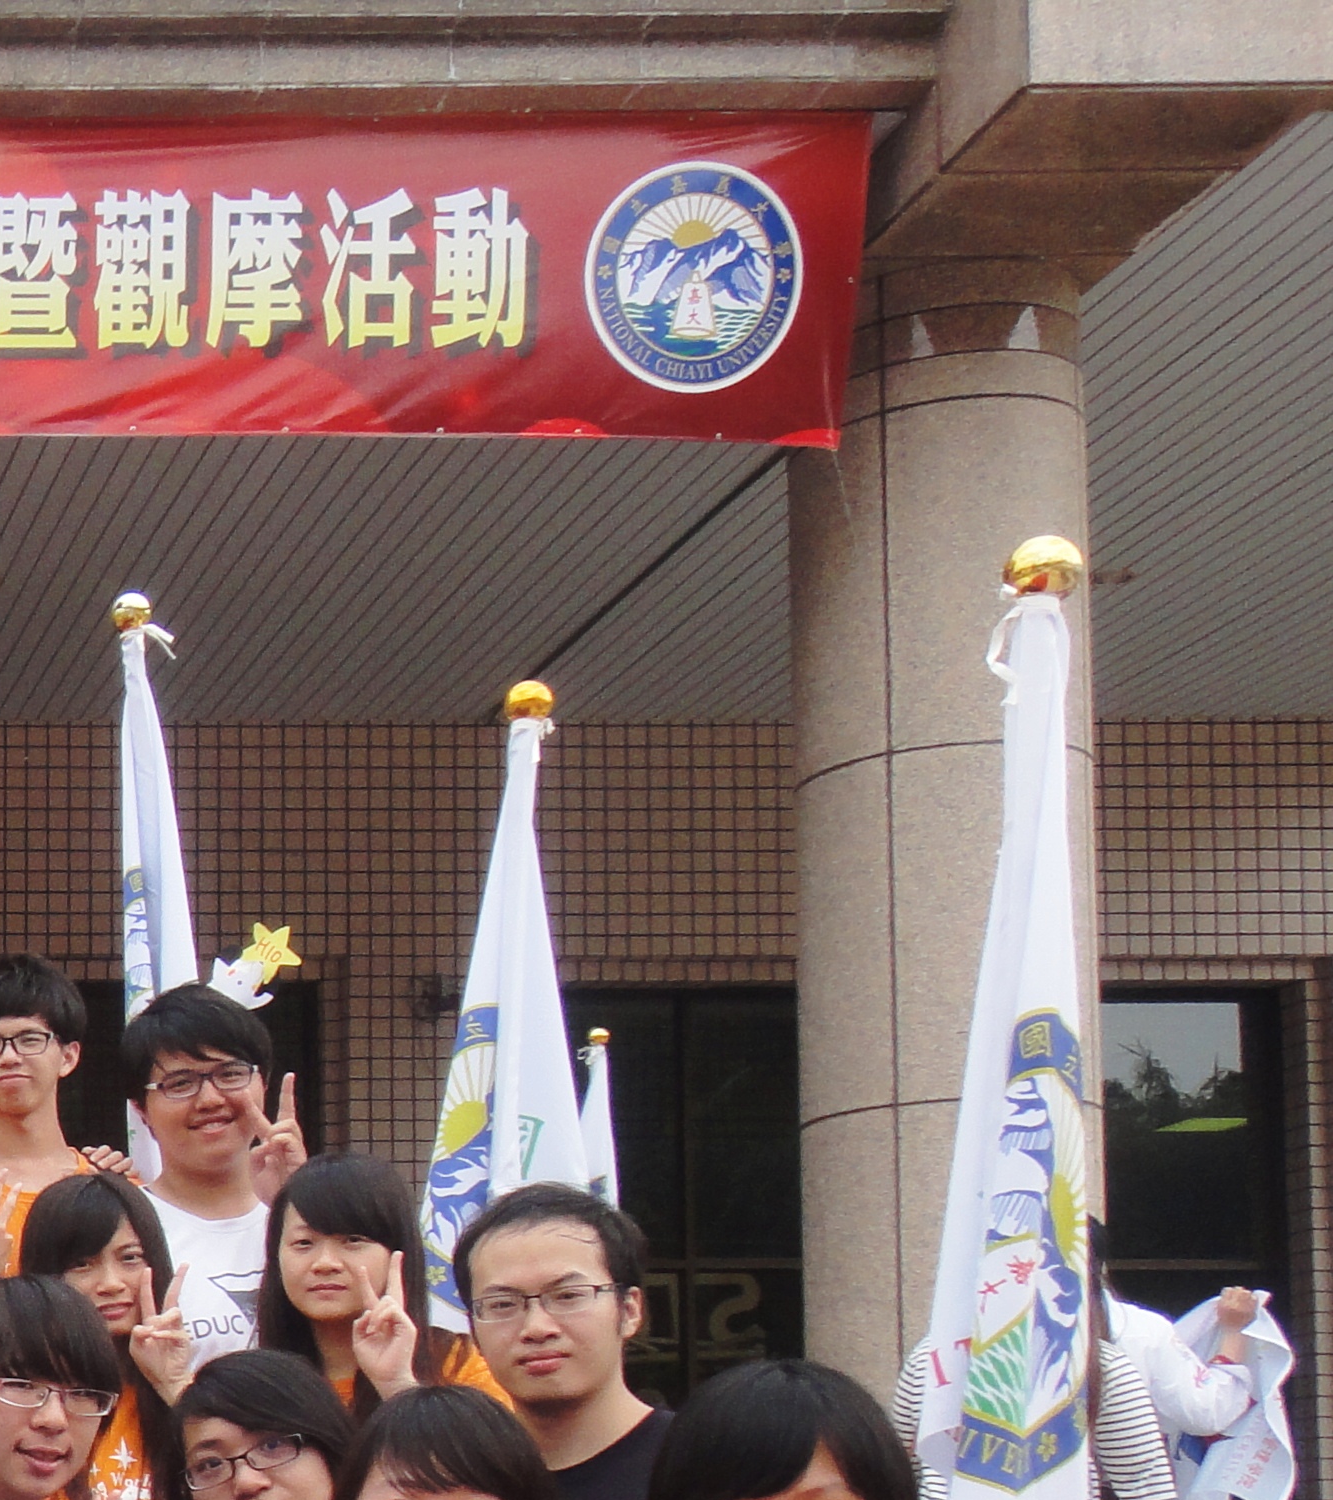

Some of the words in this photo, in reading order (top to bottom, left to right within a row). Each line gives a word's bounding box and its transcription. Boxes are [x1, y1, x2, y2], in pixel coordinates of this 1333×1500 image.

[599, 287, 650, 367] NATIONAL
[655, 356, 713, 381] CHIAYI
[717, 294, 789, 377] UNIVERSITY
